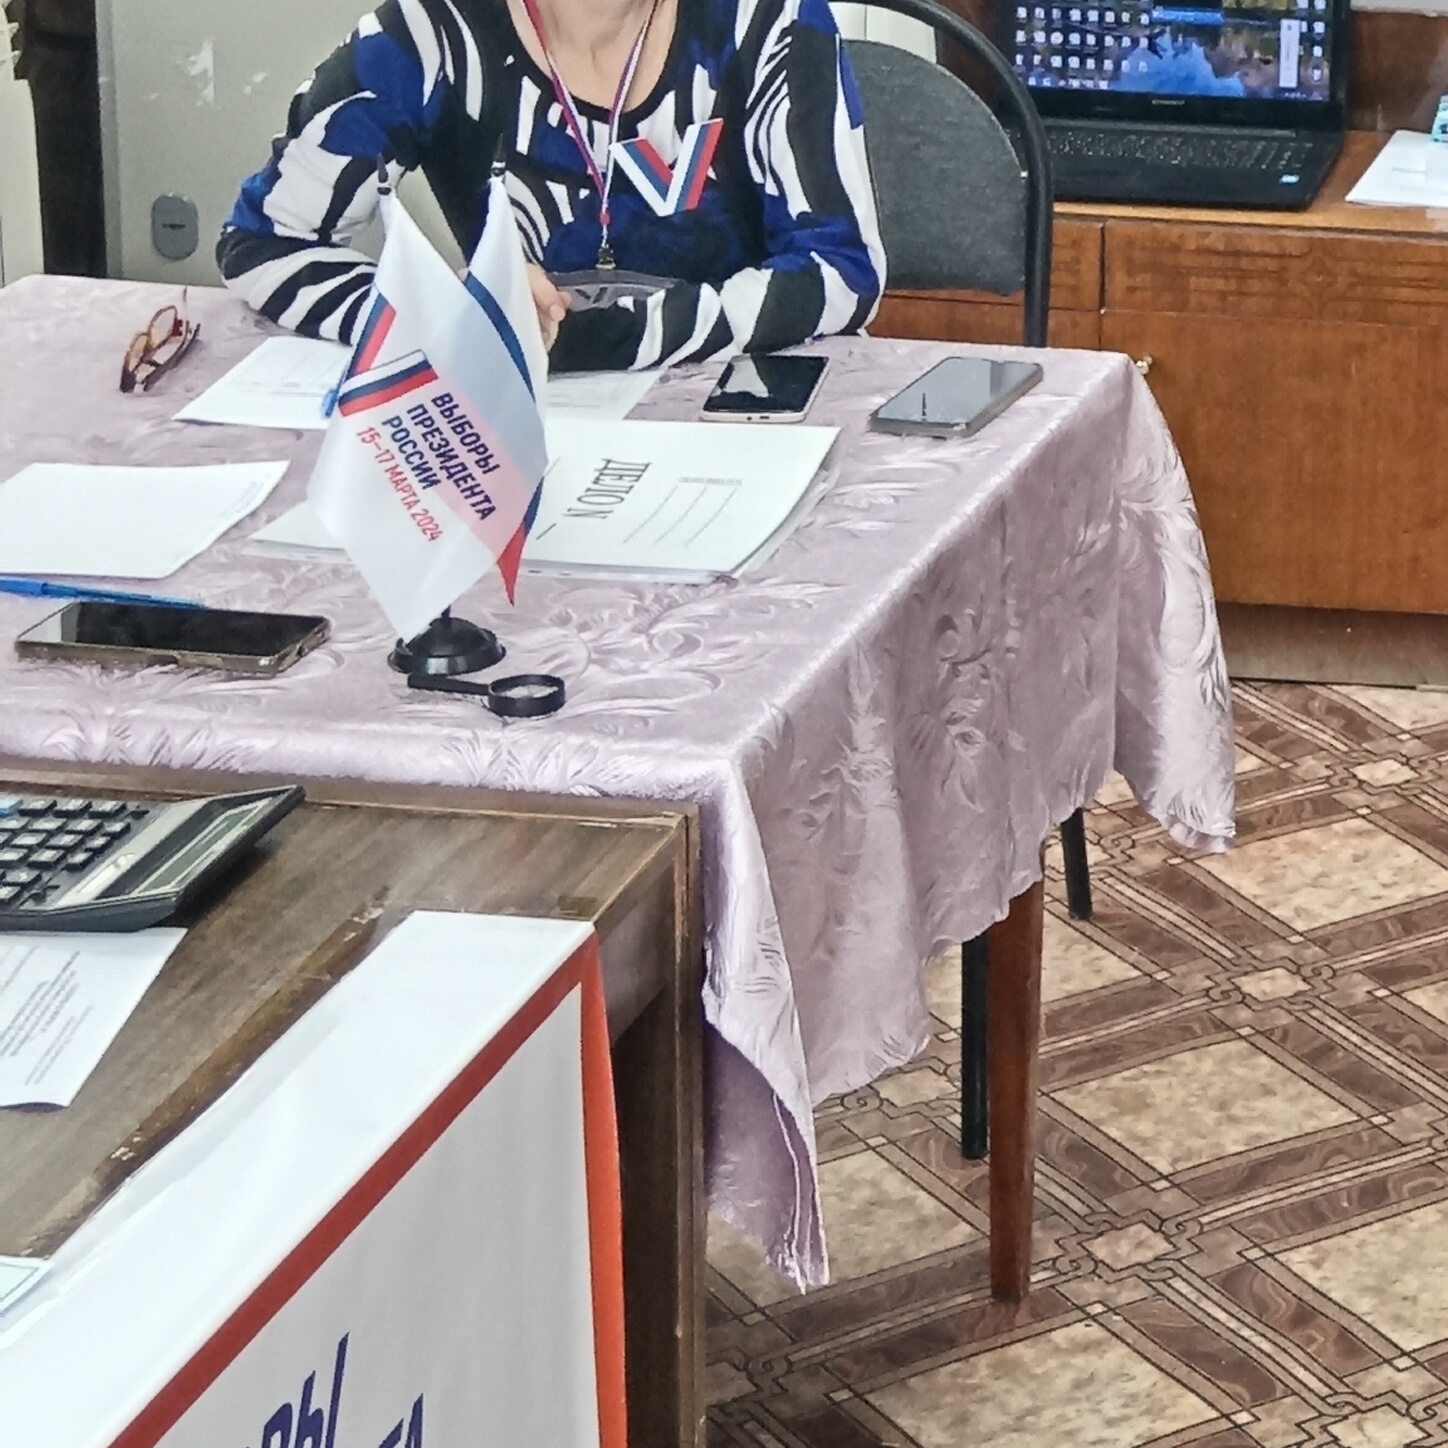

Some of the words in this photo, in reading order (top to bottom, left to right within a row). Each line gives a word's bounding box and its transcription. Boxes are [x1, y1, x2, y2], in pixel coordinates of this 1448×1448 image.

[381, 415, 442, 490] РОССИИ
[406, 403, 497, 521] ПРЕЗИДЕНТА
[431, 392, 501, 475] ВЫБОРЫ
[384, 461, 421, 511] МАРТА
[410, 508, 444, 542] 2024
[577, 458, 653, 506] ДЕЛО
